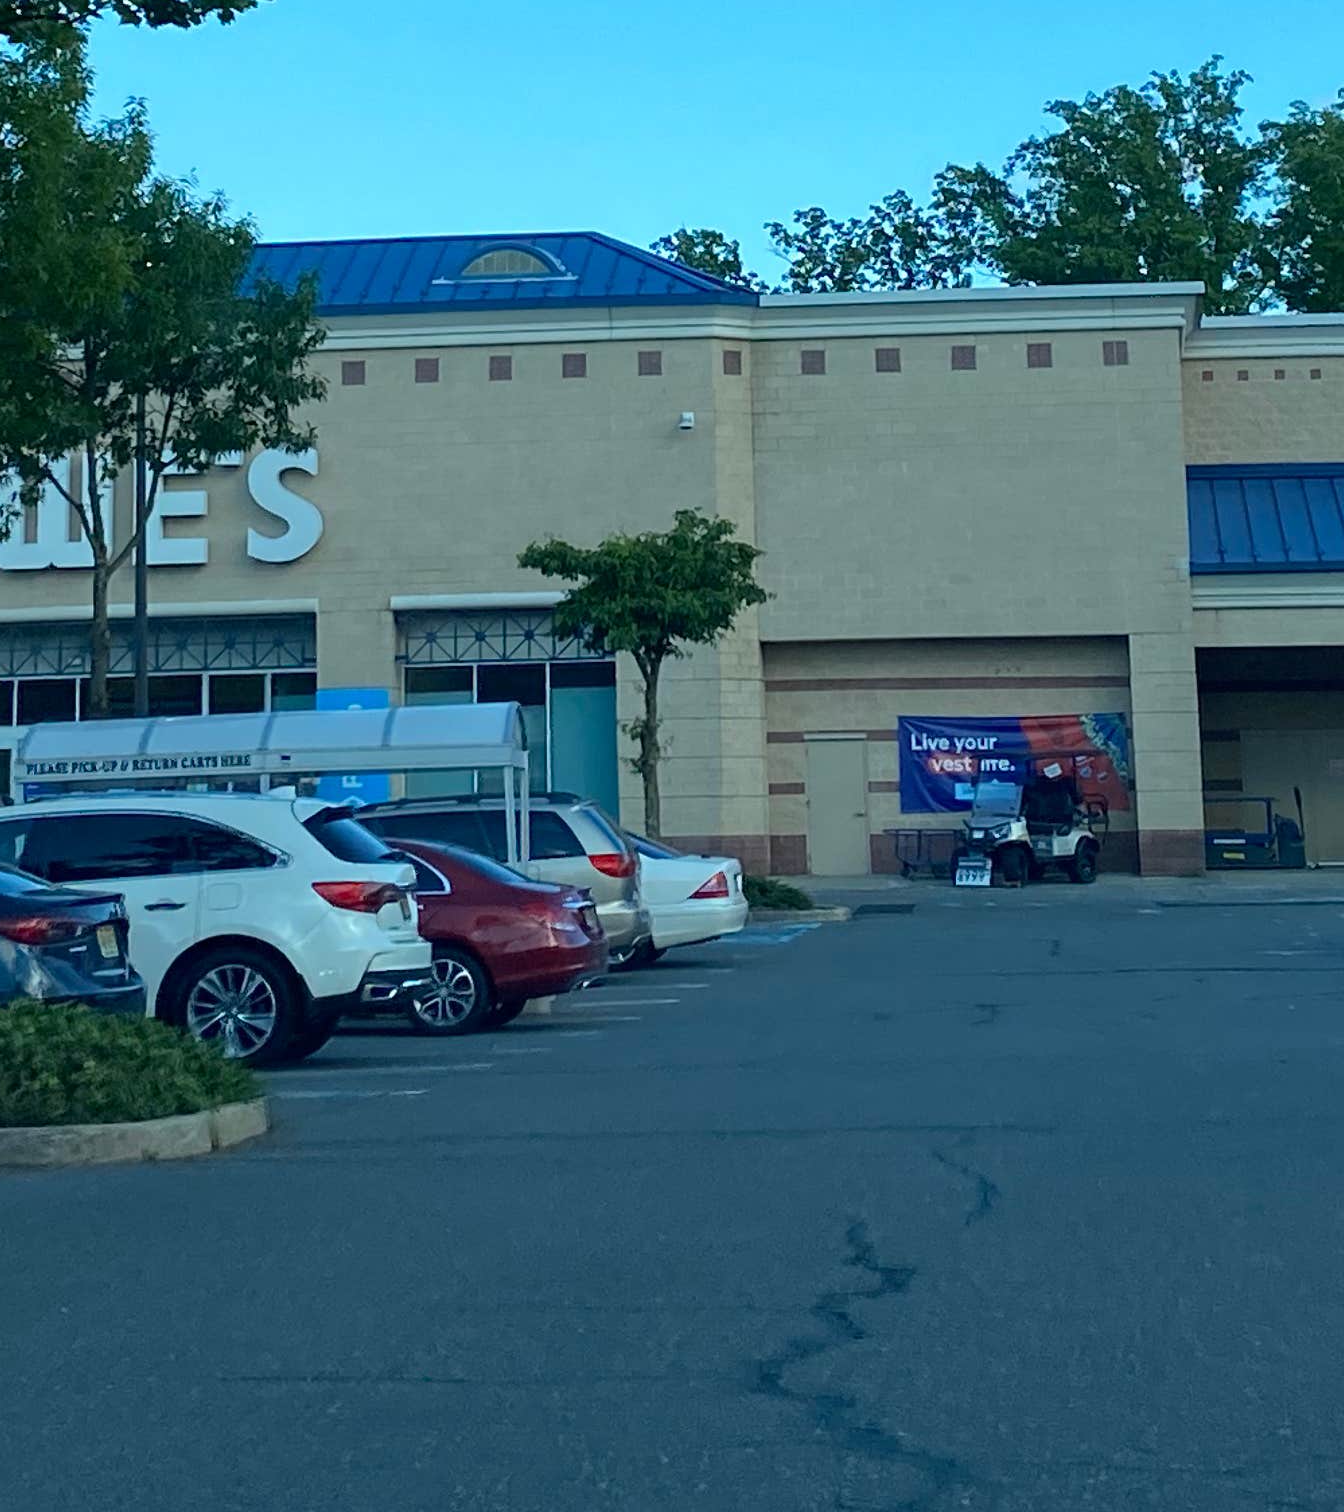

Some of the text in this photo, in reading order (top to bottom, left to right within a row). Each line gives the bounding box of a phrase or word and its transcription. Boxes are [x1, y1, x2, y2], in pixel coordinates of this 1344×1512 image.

[911, 733, 998, 753] Live your
[26, 761, 69, 775] PLEASE
[71, 760, 118, 774] PICK-UP
[132, 758, 178, 771] RETURN
[181, 756, 218, 769] CARTS
[221, 754, 251, 767] HERE
[931, 756, 973, 772] vest
